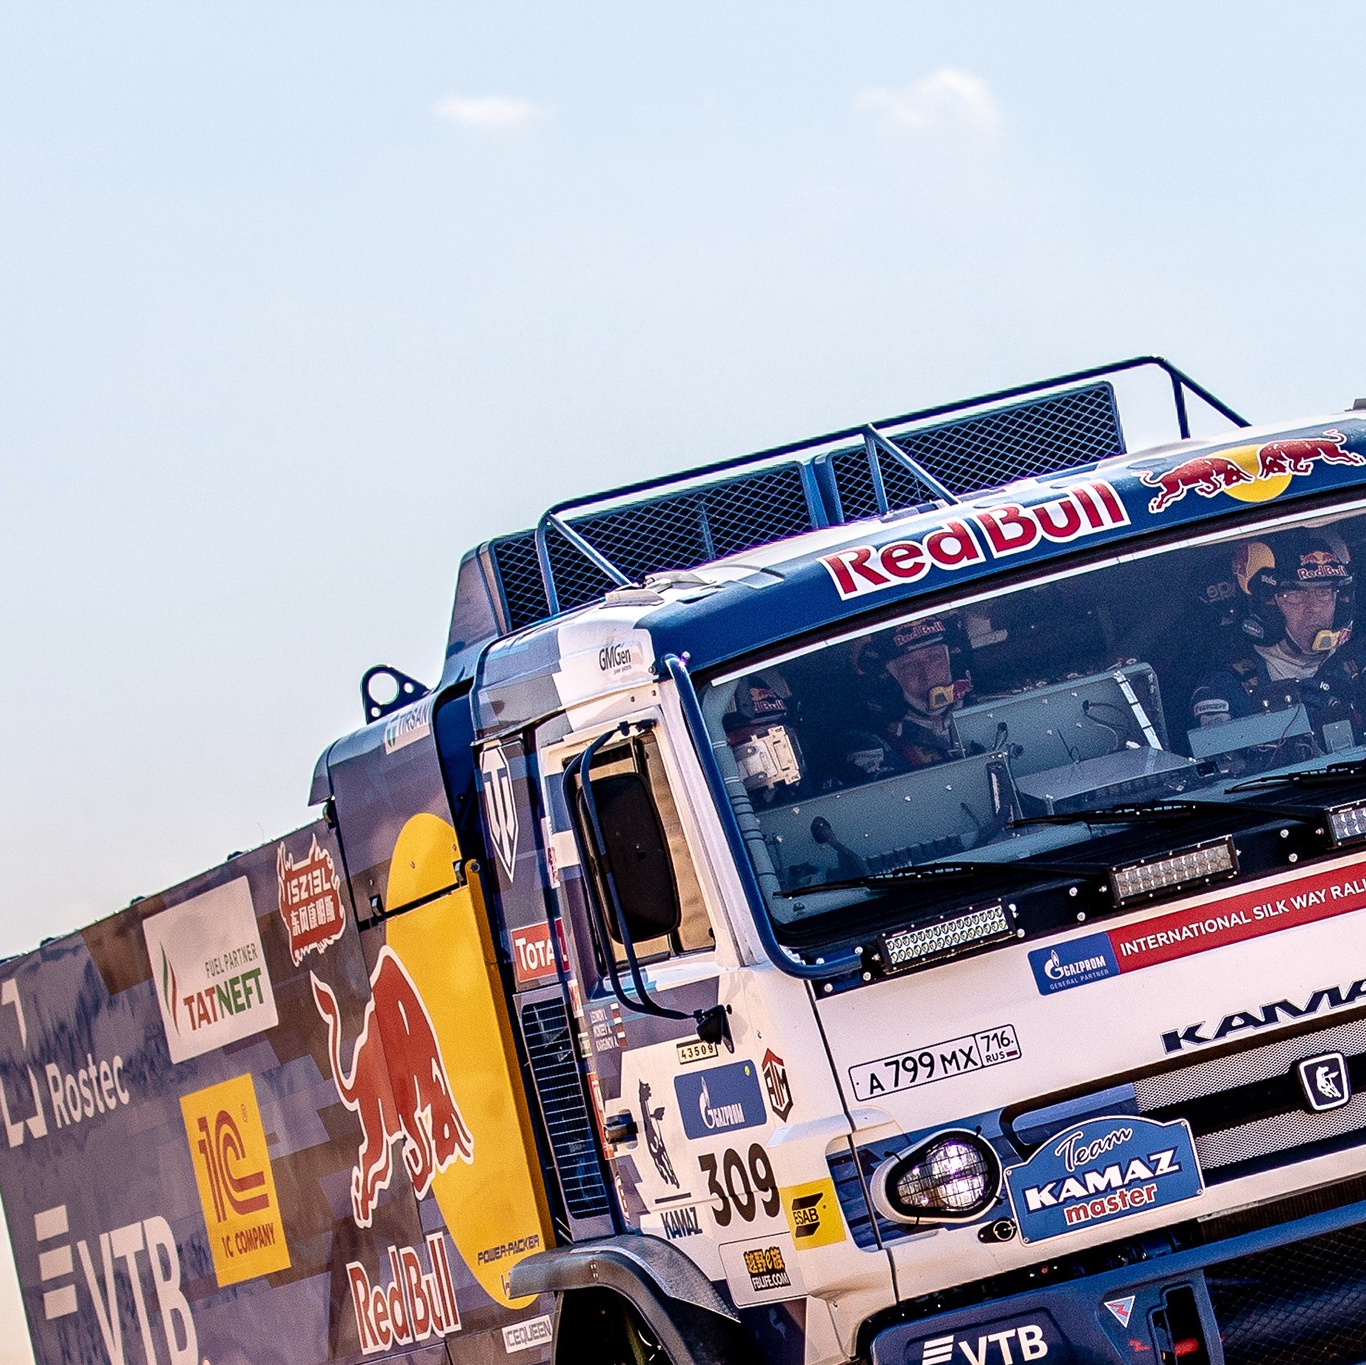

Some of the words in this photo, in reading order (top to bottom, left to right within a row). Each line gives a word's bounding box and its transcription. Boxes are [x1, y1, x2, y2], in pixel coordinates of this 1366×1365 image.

[821, 520, 980, 597] Red
[979, 481, 1129, 556] Bull
[1297, 566, 1325, 580] Red
[1324, 565, 1348, 577] Bull
[599, 644, 632, 671] GMGen
[1119, 911, 1252, 957] INTERNATIONAL
[1253, 901, 1290, 921] SILK
[1290, 888, 1329, 912] WAY
[205, 958, 225, 979] FUEL
[225, 943, 258, 972] PARTNER
[1063, 955, 1106, 976] GAZPROM
[1049, 978, 1079, 990] GENERAL
[1080, 969, 1109, 981] PARTNER
[183, 967, 264, 1031] TATNEFT
[681, 1044, 714, 1060] 43509
[980, 1030, 1011, 1052] 716
[986, 1051, 1006, 1063] RUS
[884, 1051, 936, 1089] 799
[46, 1053, 131, 1129] Rostec
[715, 1103, 746, 1128] GAZPROM
[1055, 1127, 1132, 1172] Team
[699, 1142, 781, 1228] 309
[1024, 1147, 1181, 1213] KAMAZ
[793, 1203, 820, 1227] ESAB
[1066, 1182, 1156, 1226] master
[235, 1222, 276, 1257] COMPANY
[660, 1207, 703, 1240] KAMAZ
[346, 1246, 410, 1354] Red
[401, 1233, 461, 1342] Bull
[751, 1272, 790, 1289] FBLIFE.COM
